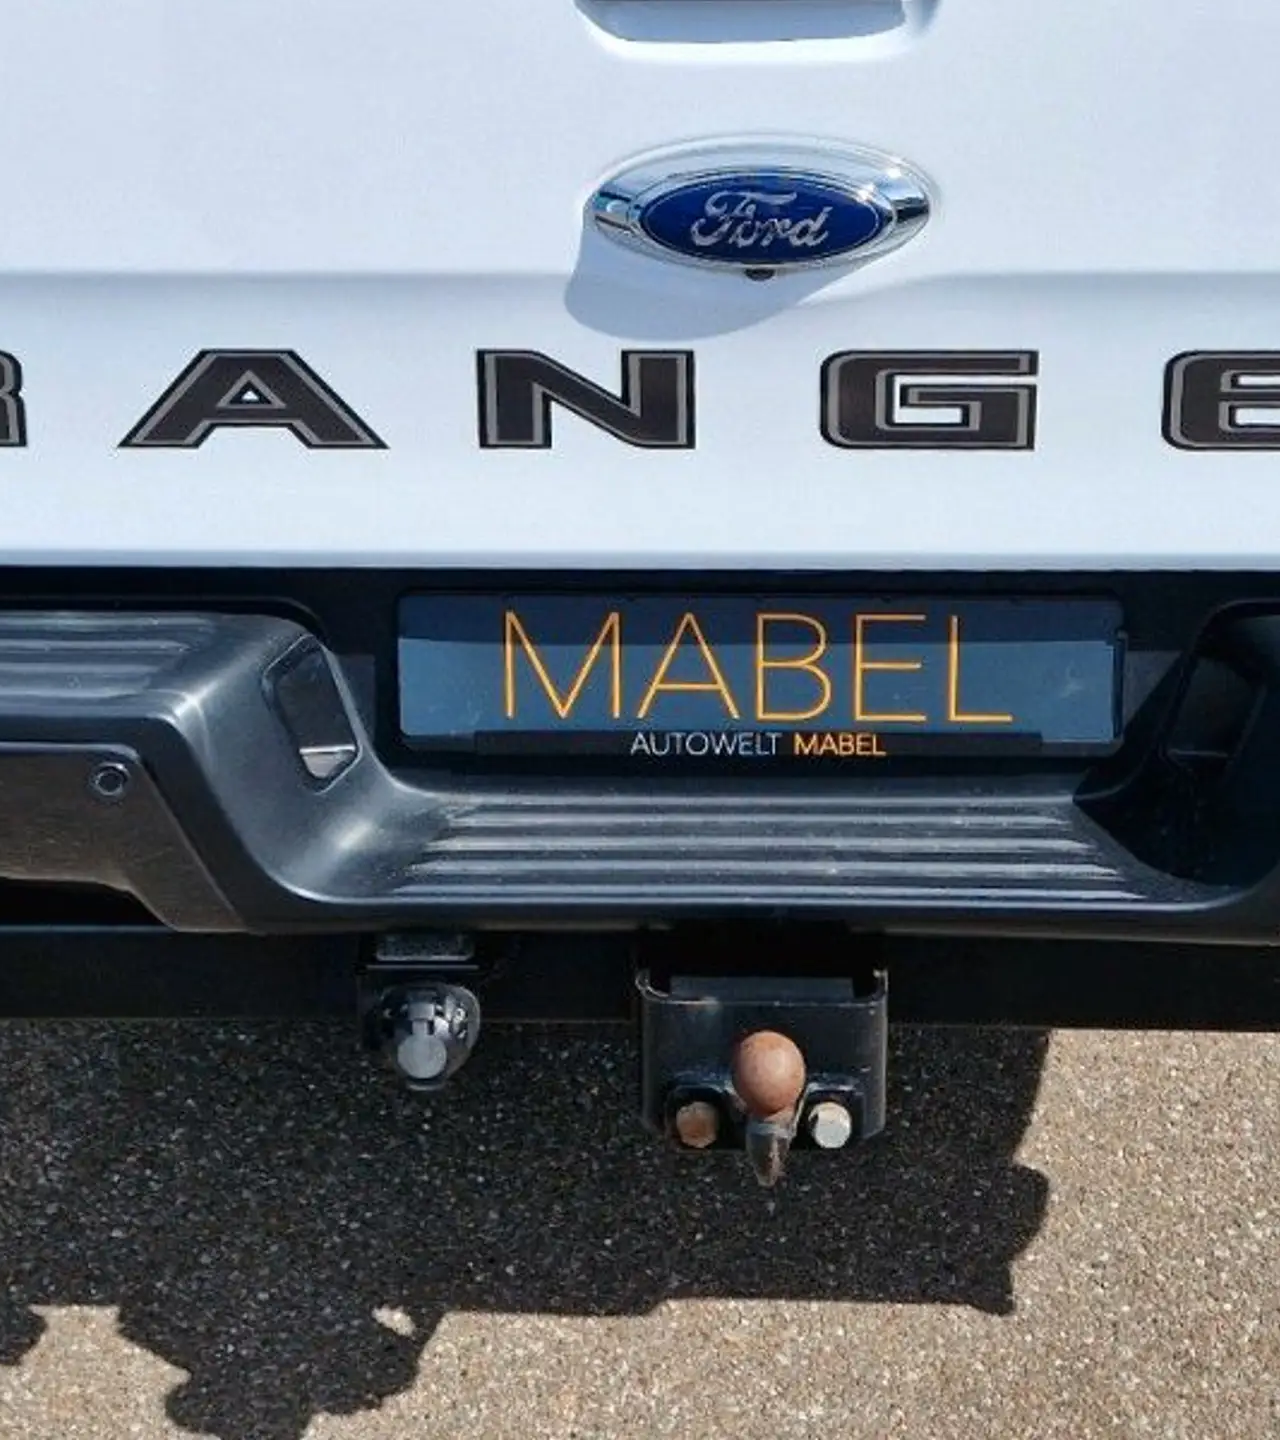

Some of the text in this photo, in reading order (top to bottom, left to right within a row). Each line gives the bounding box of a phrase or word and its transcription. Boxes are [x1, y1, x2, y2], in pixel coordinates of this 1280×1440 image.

[690, 189, 834, 248] Ford
[503, 610, 1014, 725] MABEL
[630, 731, 887, 757] AUTOWELT MABEL
